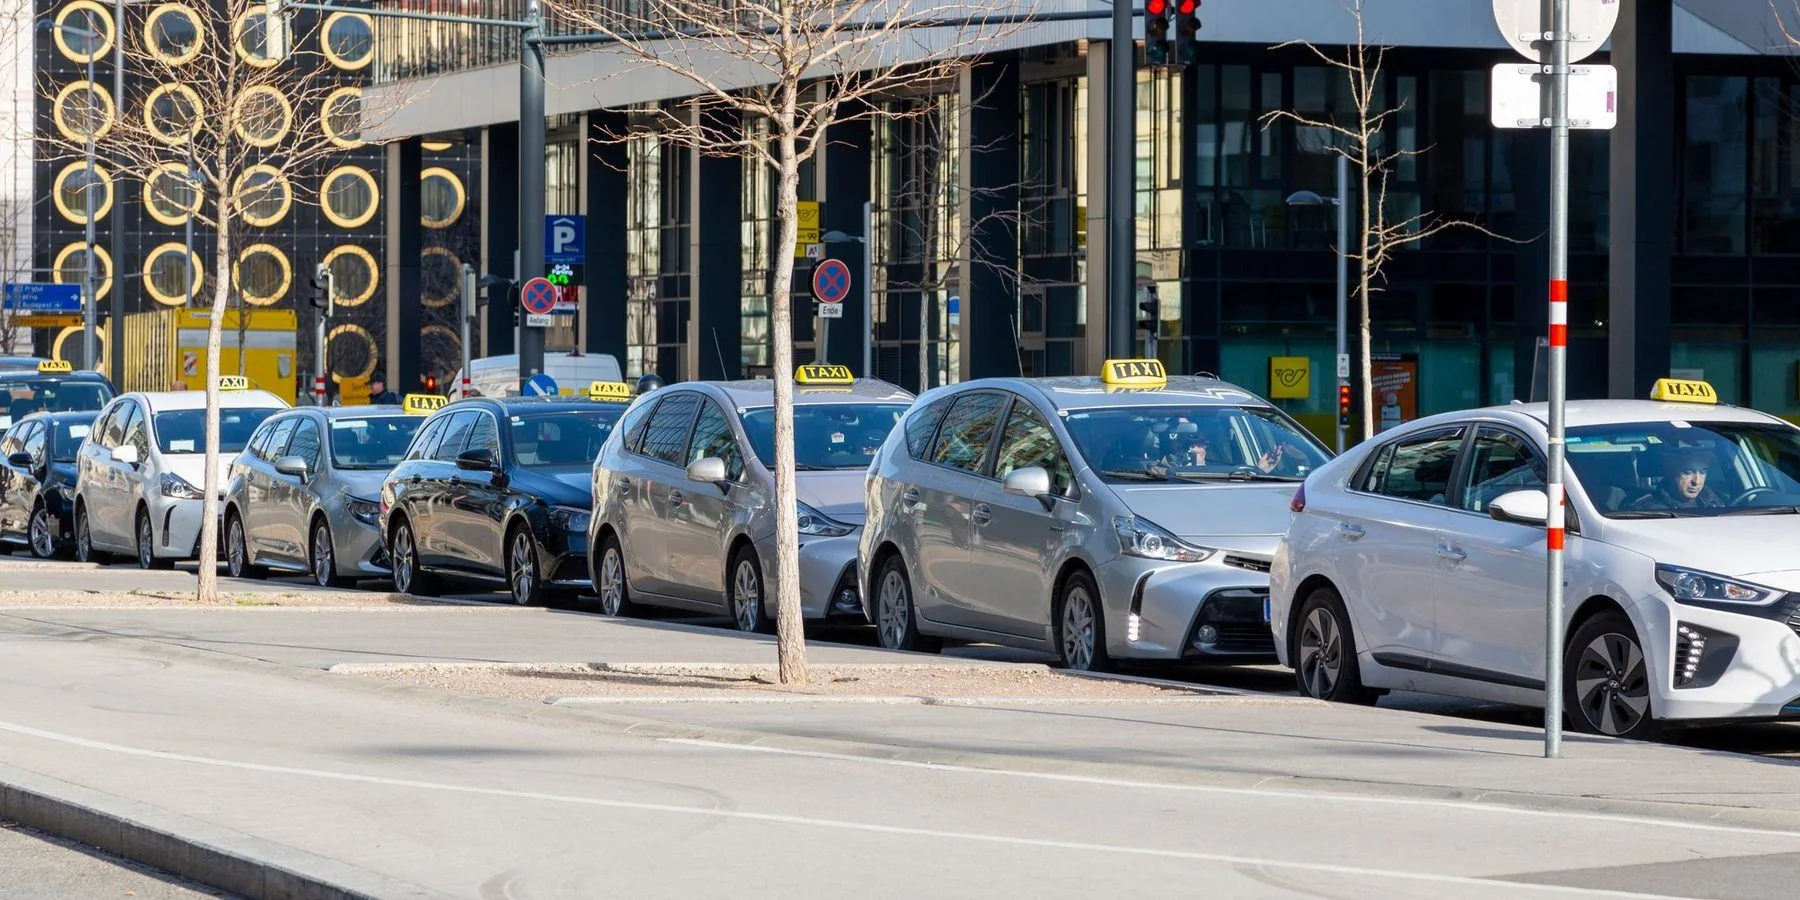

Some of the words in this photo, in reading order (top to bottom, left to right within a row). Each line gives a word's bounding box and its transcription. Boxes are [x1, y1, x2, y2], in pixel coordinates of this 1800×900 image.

[823, 306, 839, 315] Ende
[529, 316, 549, 326] Anfang
[805, 367, 847, 378] TAXI
[1115, 362, 1161, 378] TAXI
[219, 378, 244, 387] AXI
[595, 384, 625, 393] TAXI
[1667, 382, 1710, 397] TAXI
[411, 397, 445, 410] TAXI
